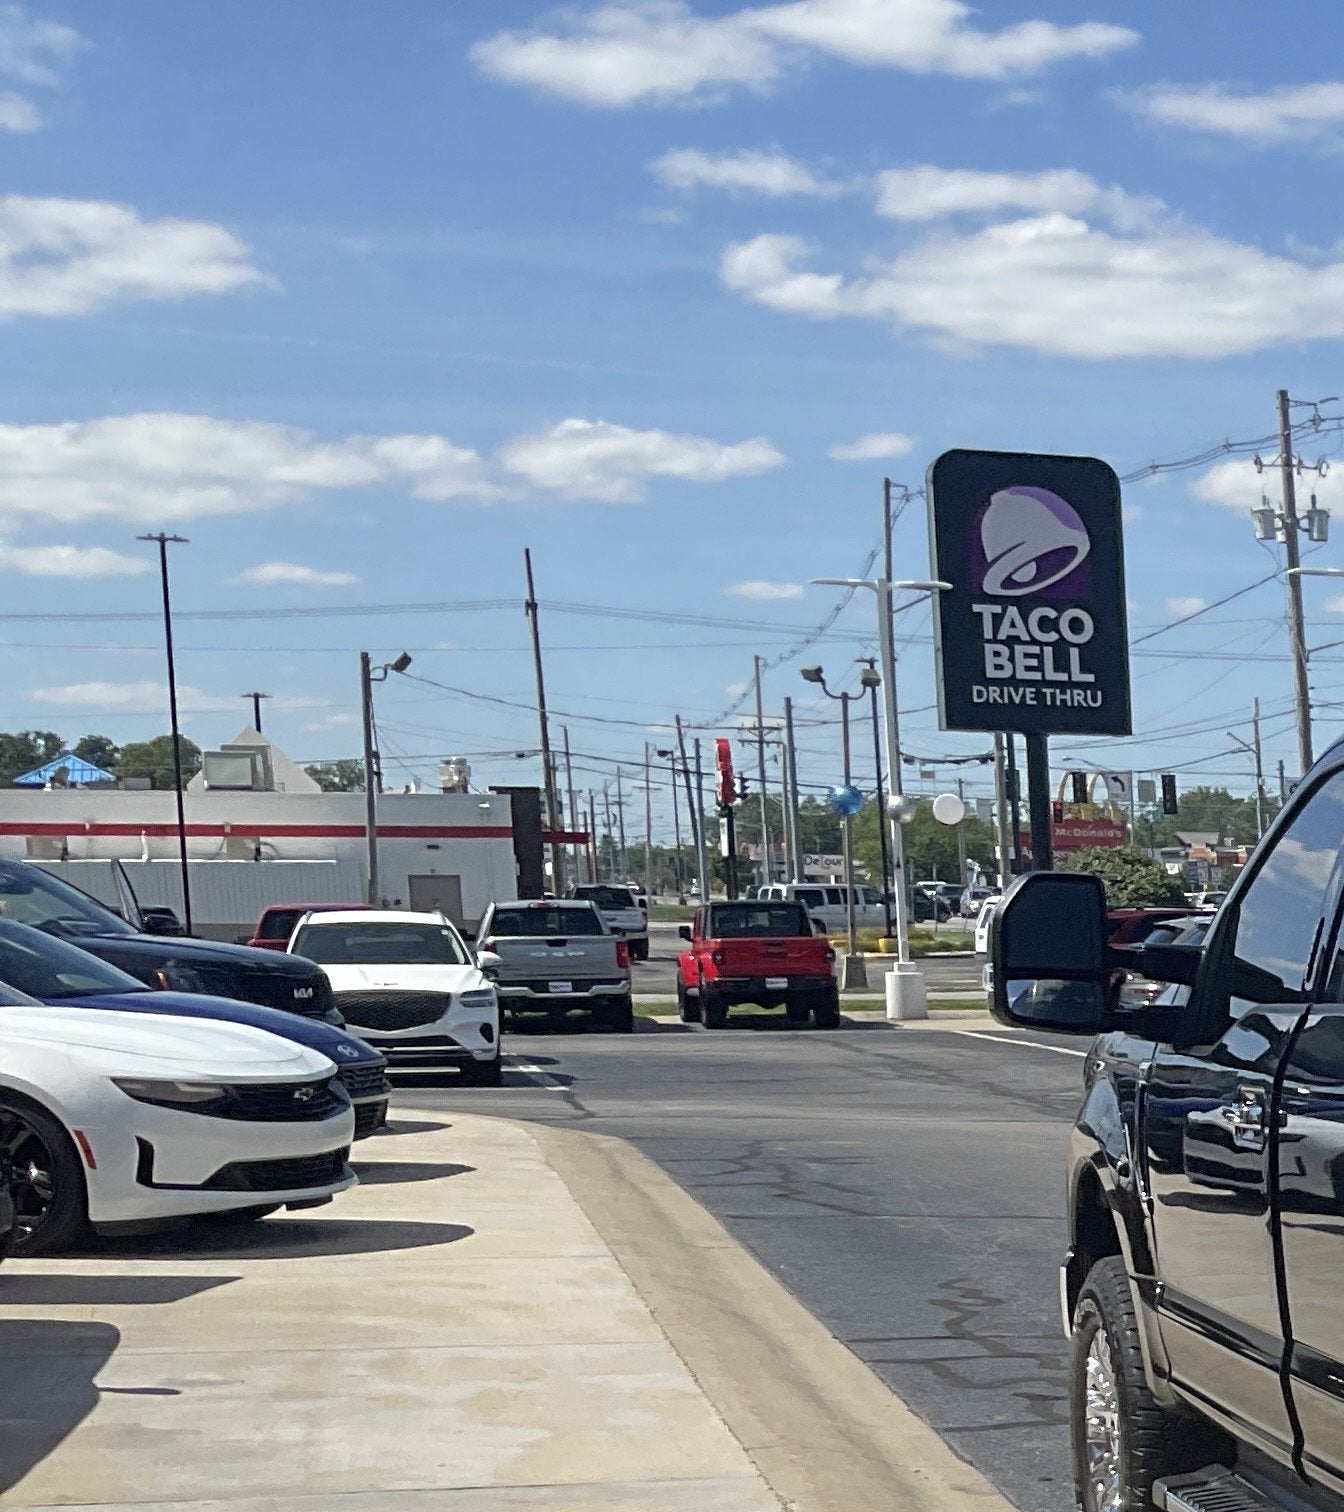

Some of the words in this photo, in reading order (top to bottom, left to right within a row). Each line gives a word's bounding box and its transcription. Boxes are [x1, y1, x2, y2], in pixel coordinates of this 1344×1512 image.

[972, 603, 1094, 644] TACO
[984, 643, 1095, 682] BELL
[972, 685, 1037, 705] DRIVE
[1041, 688, 1102, 708] THRU
[1055, 827, 1123, 838] McDonald's
